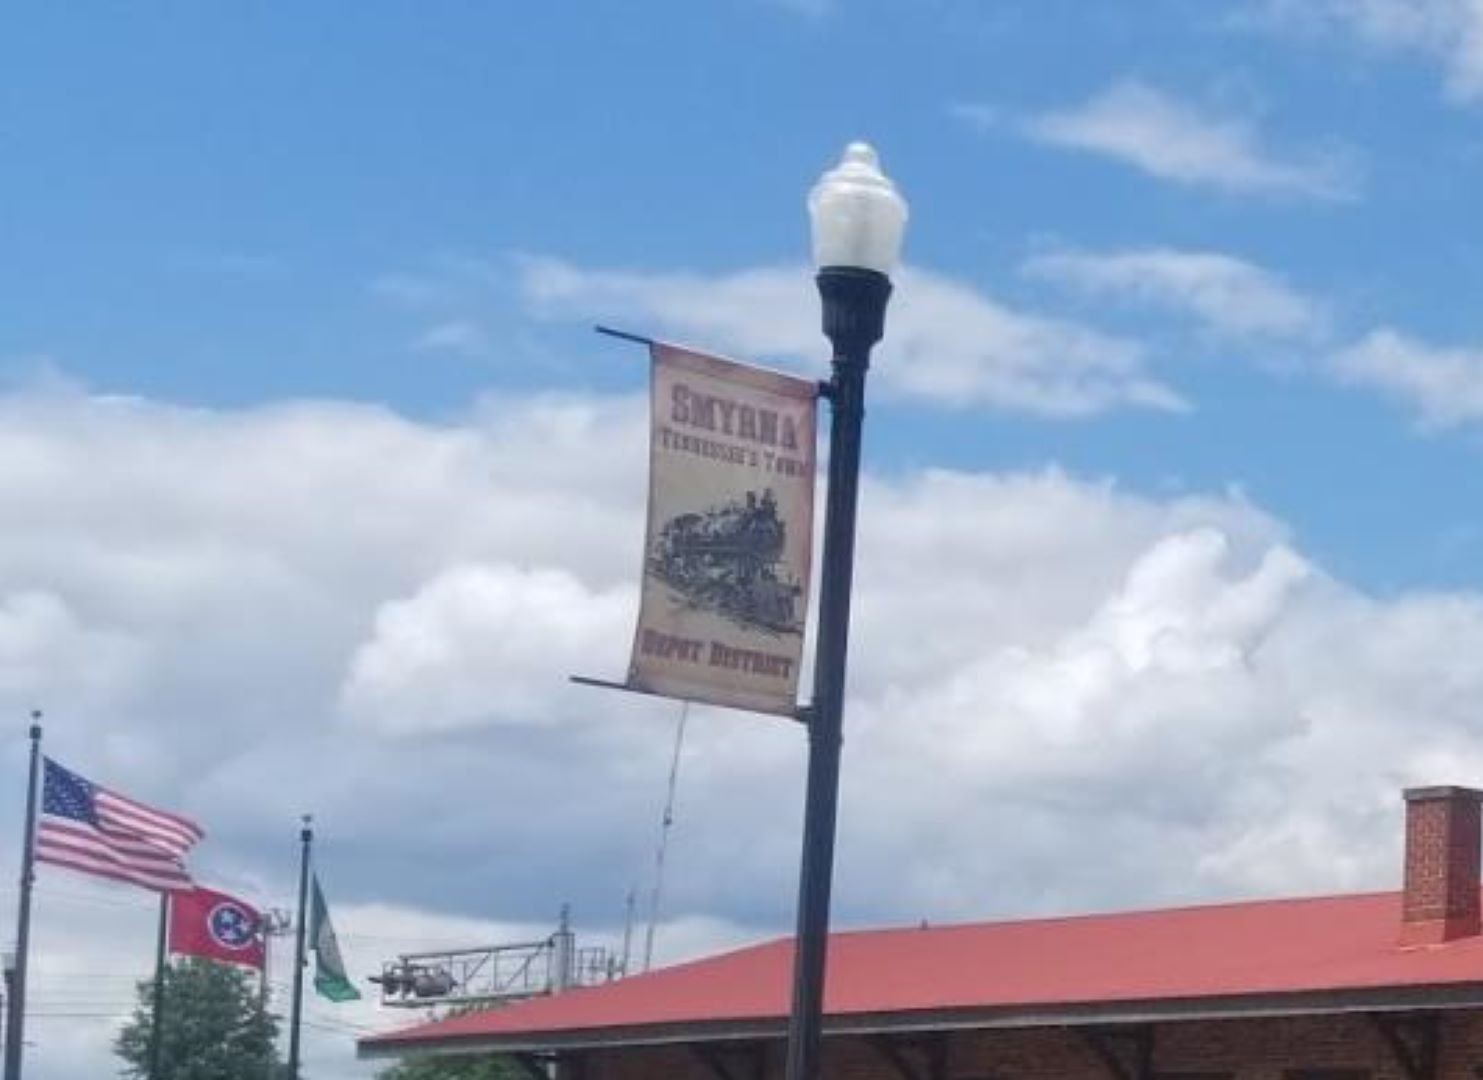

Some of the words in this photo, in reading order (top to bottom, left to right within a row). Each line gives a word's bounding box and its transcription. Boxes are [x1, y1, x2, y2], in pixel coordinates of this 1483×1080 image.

[671, 383, 798, 451] SMYRNA
[640, 628, 702, 665] DEPOT
[709, 640, 794, 679] DISTRICT
